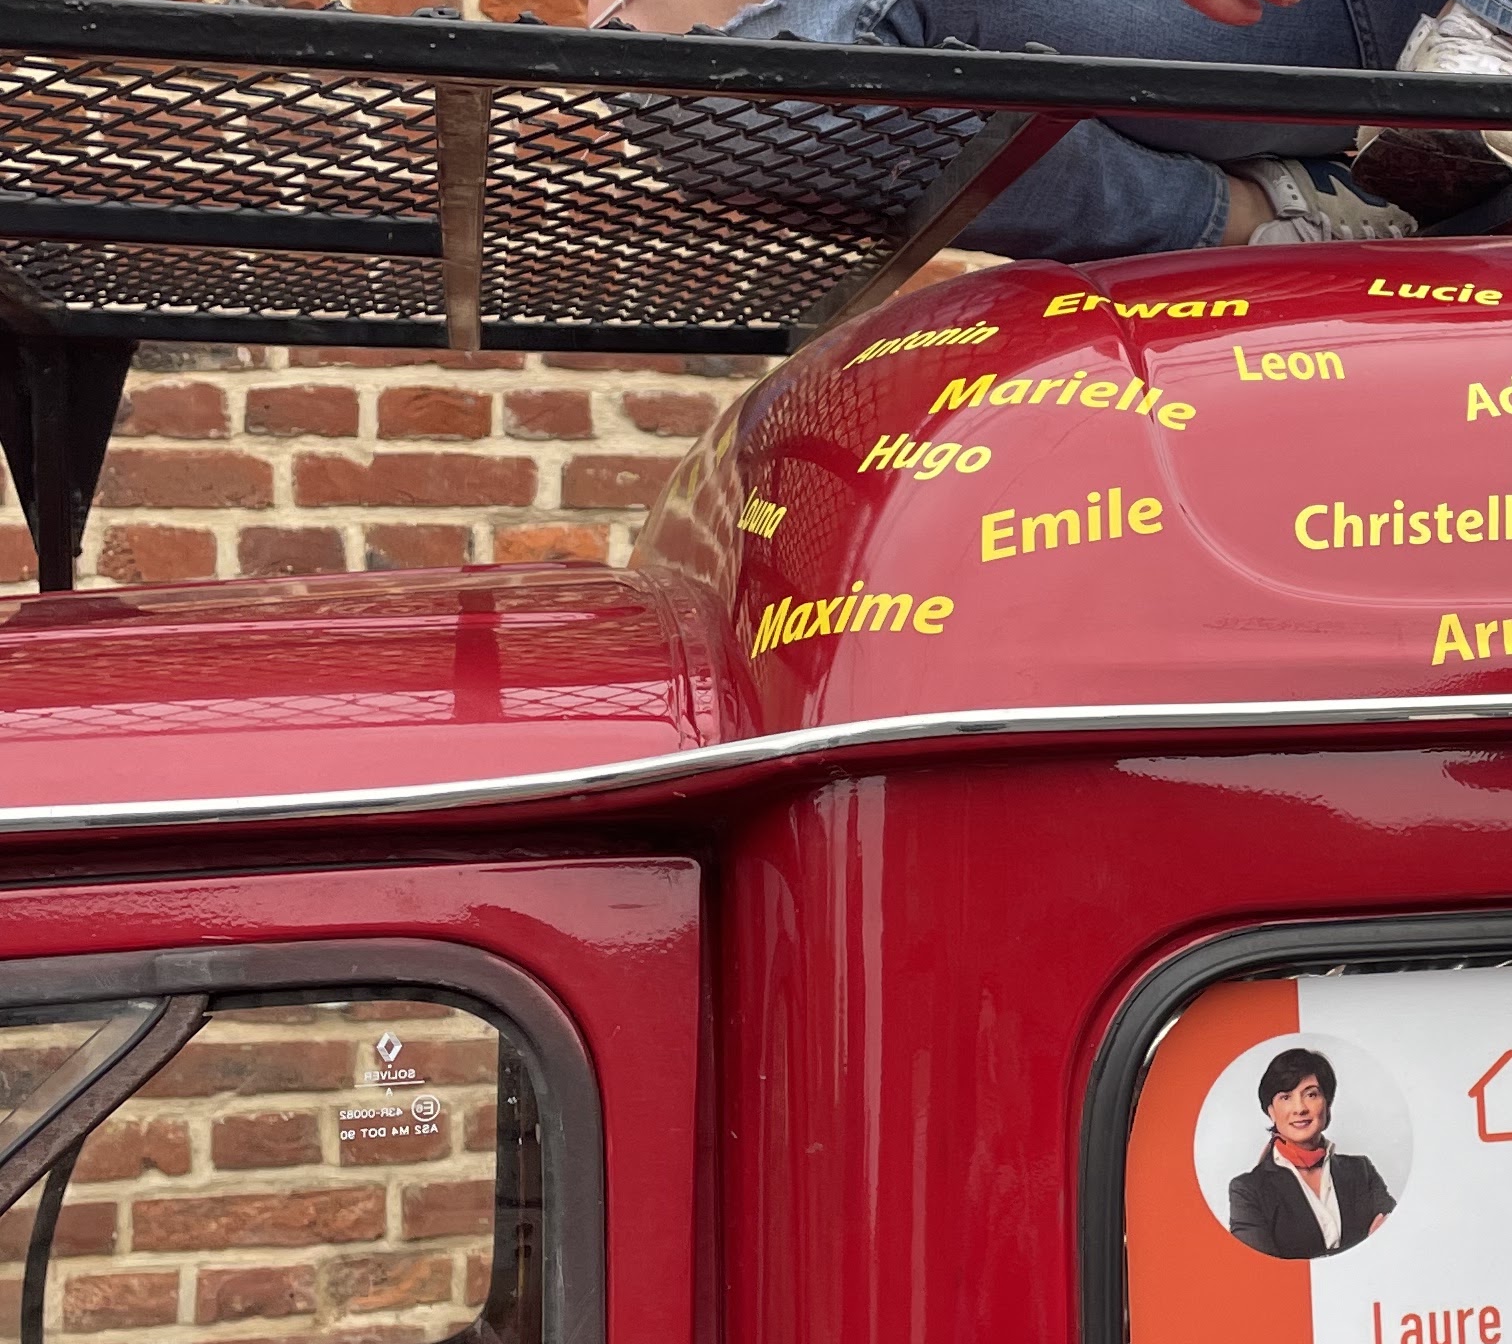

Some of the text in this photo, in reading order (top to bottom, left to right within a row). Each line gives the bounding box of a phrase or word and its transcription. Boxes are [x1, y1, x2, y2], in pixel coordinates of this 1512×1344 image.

[1042, 292, 1250, 319] Erwan
[1366, 278, 1504, 306] Lucie
[842, 321, 1000, 370] Antonin
[1232, 345, 1346, 383] Leon
[927, 369, 1198, 431] Marielle
[857, 433, 992, 481] Hugo
[736, 485, 788, 539] Louna
[980, 487, 1164, 563] Emile
[750, 580, 956, 660] Maxime
